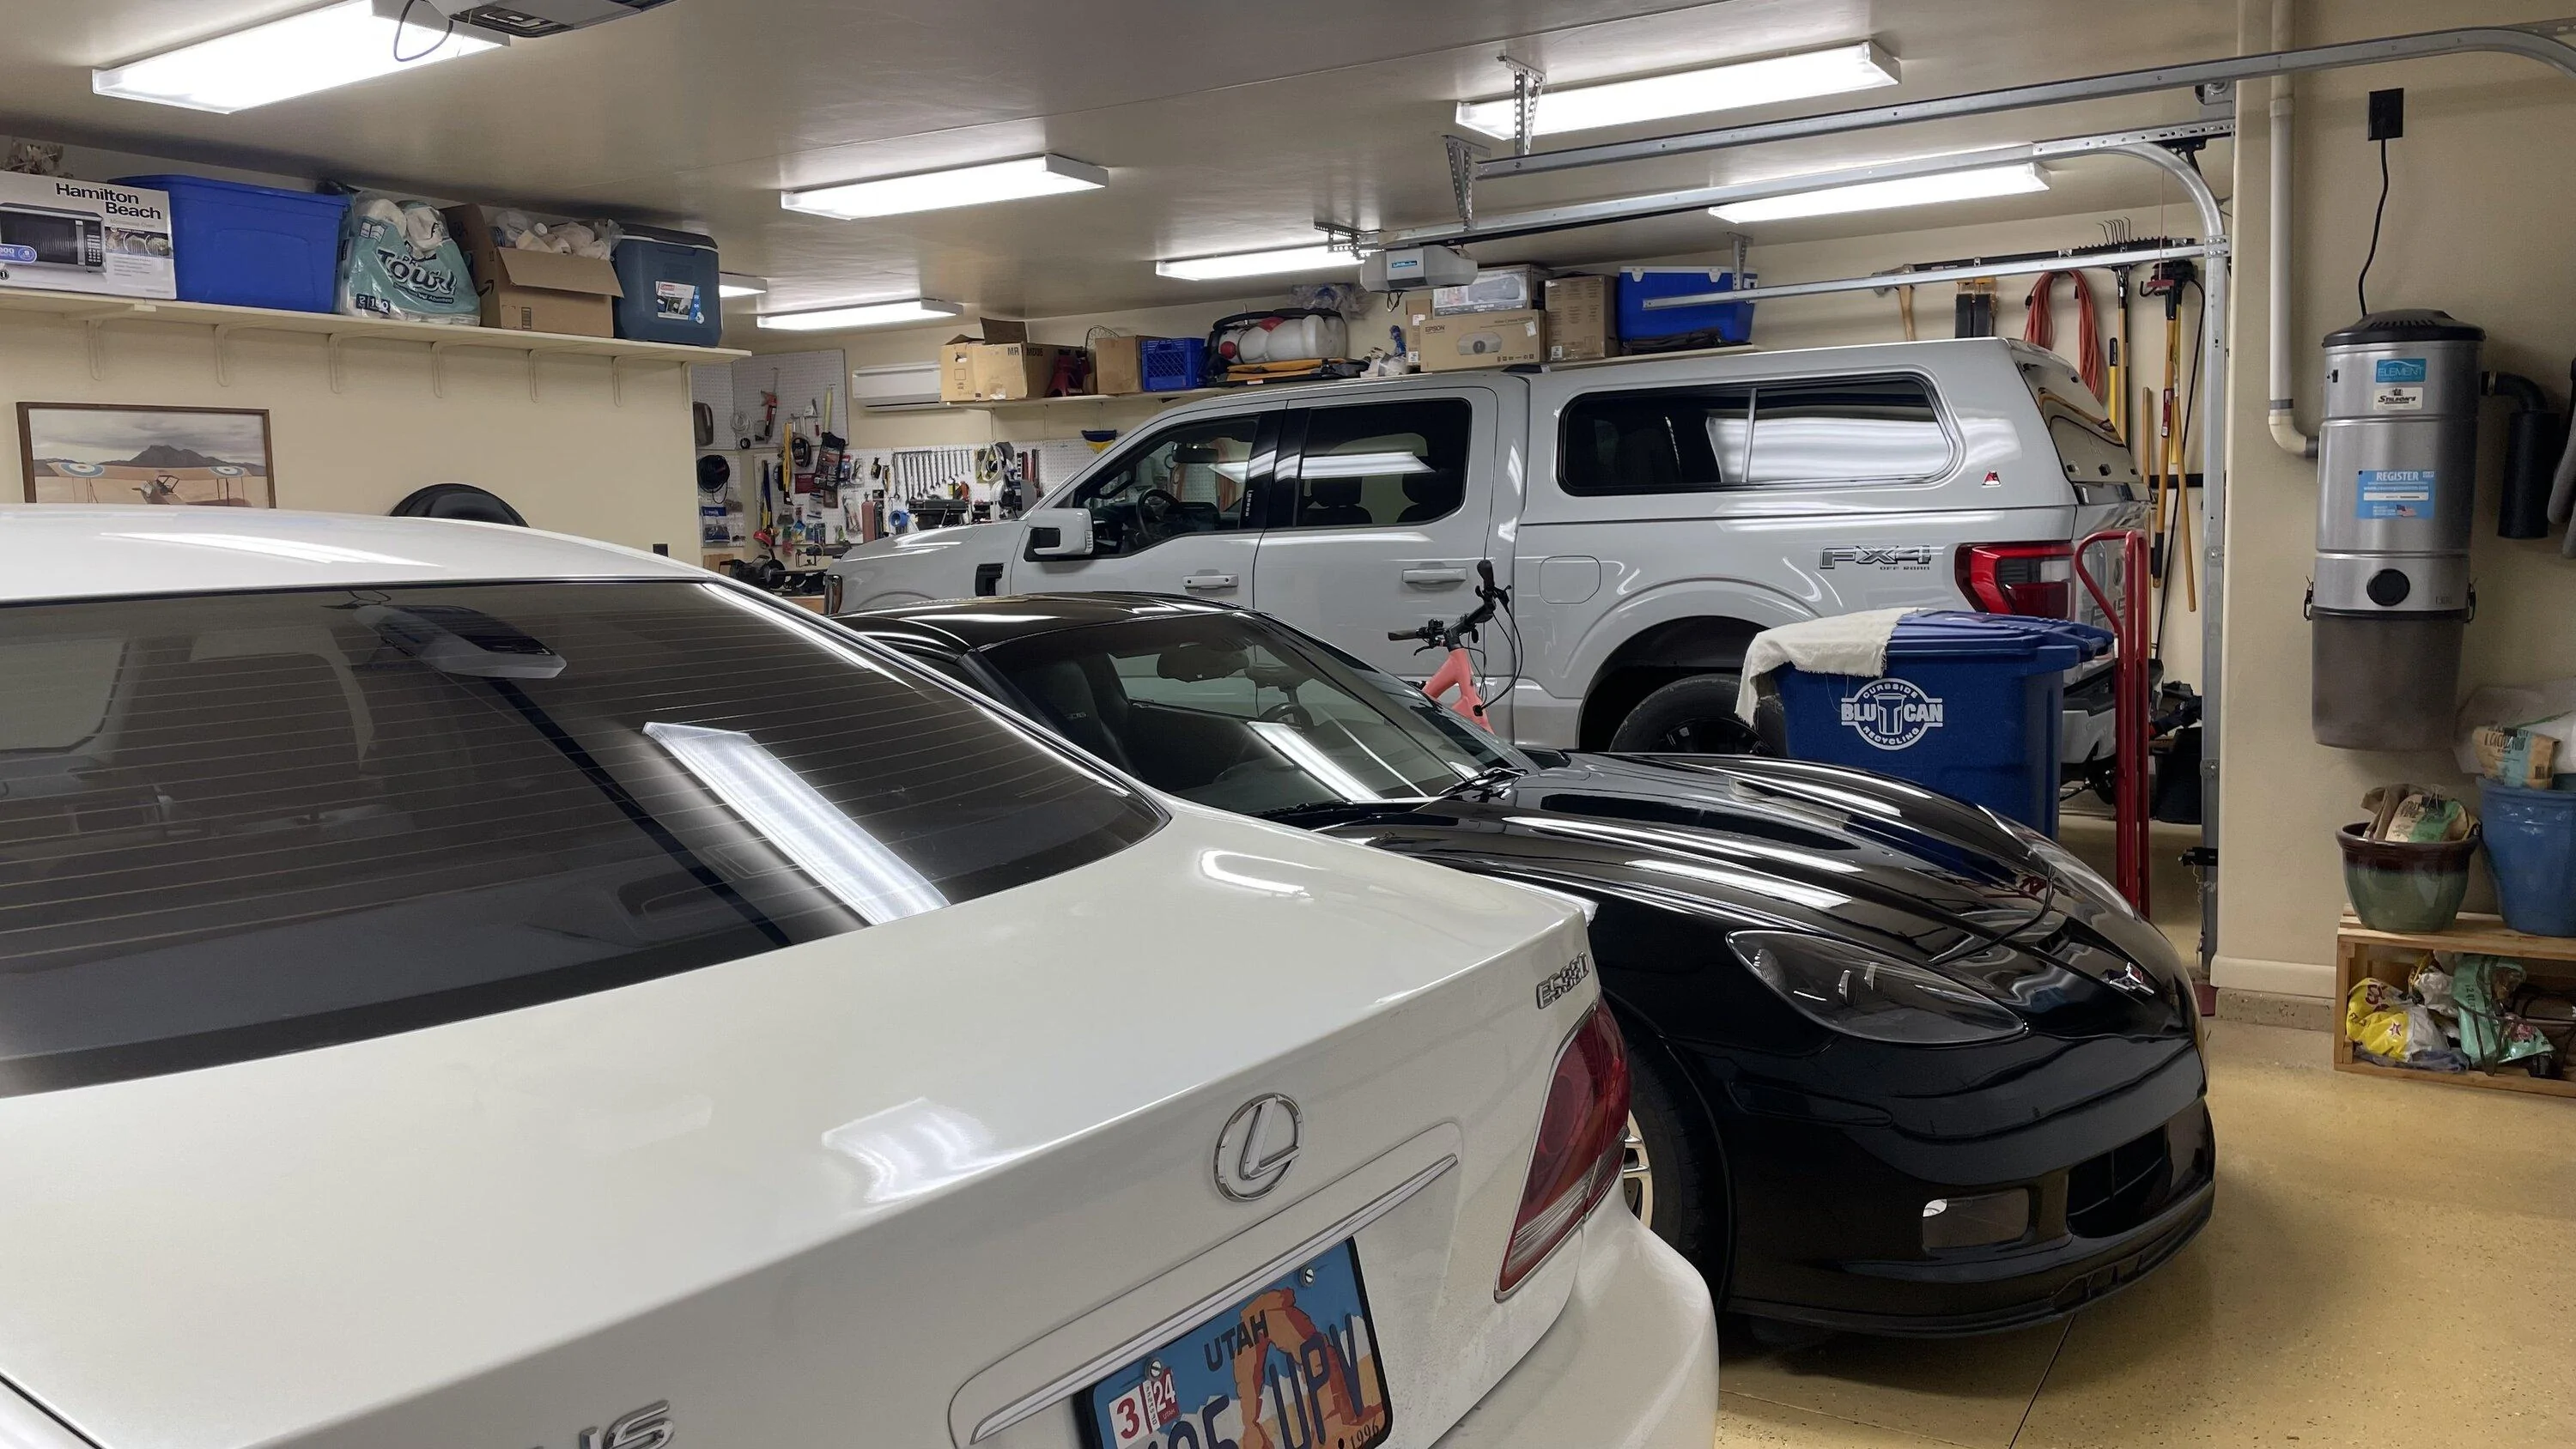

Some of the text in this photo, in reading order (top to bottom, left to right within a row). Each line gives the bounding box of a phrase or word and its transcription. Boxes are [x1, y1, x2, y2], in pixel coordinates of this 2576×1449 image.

[55, 182, 140, 205] Hamilton
[105, 202, 161, 220] Beach
[1007, 347, 1020, 356] MR
[2379, 367, 2423, 377] ELEMENT
[2376, 471, 2419, 481] REGISTER
[1819, 545, 1931, 570] FX4
[1862, 683, 1918, 699] CURBSIDE
[1841, 703, 1943, 722] BLU CAN
[1862, 725, 1920, 745] RECYCLING
[1204, 1310, 1269, 1372] UTAH
[1117, 1397, 1140, 1440] 3
[1153, 1373, 1176, 1412] 24
